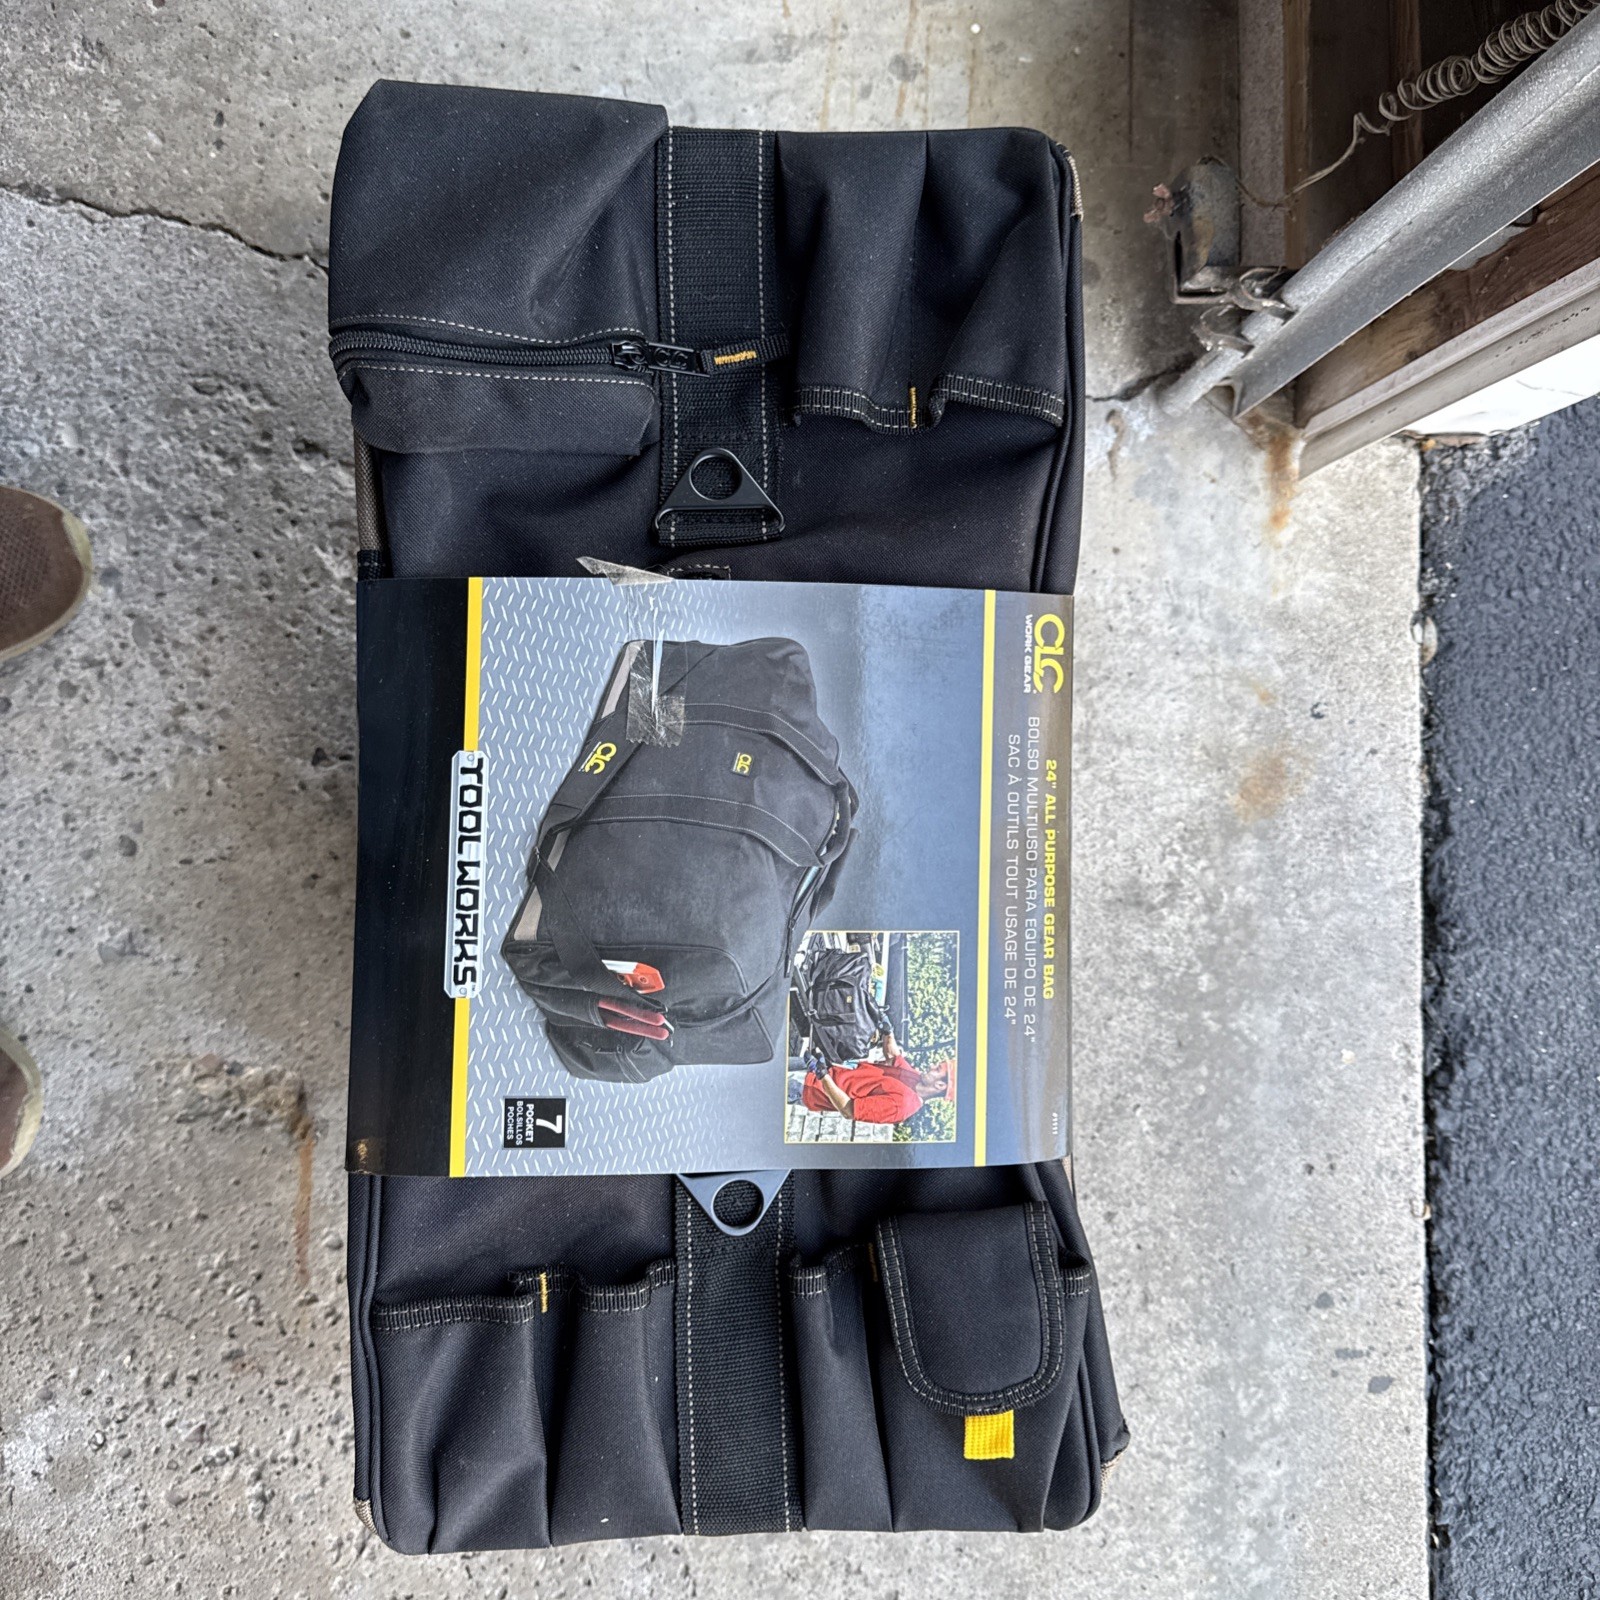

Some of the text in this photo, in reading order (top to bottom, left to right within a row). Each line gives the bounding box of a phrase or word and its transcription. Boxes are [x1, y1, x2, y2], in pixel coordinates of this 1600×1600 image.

[1023, 614, 1033, 694] WORK GEAR
[1004, 734, 1022, 1025] SAC À OUTILS TOUT USAGE DE 24"
[1023, 716, 1040, 1043] BOLSO MULTIUSO PARA EQUIPO DE 24"
[1043, 759, 1057, 999] 24" ALL PURPOSE GEAR BAG
[506, 1106, 515, 1140] POCHES
[515, 1100, 524, 1146] BOLSILLOS
[525, 1103, 535, 1143] POCKET
[535, 1114, 563, 1134] 7
